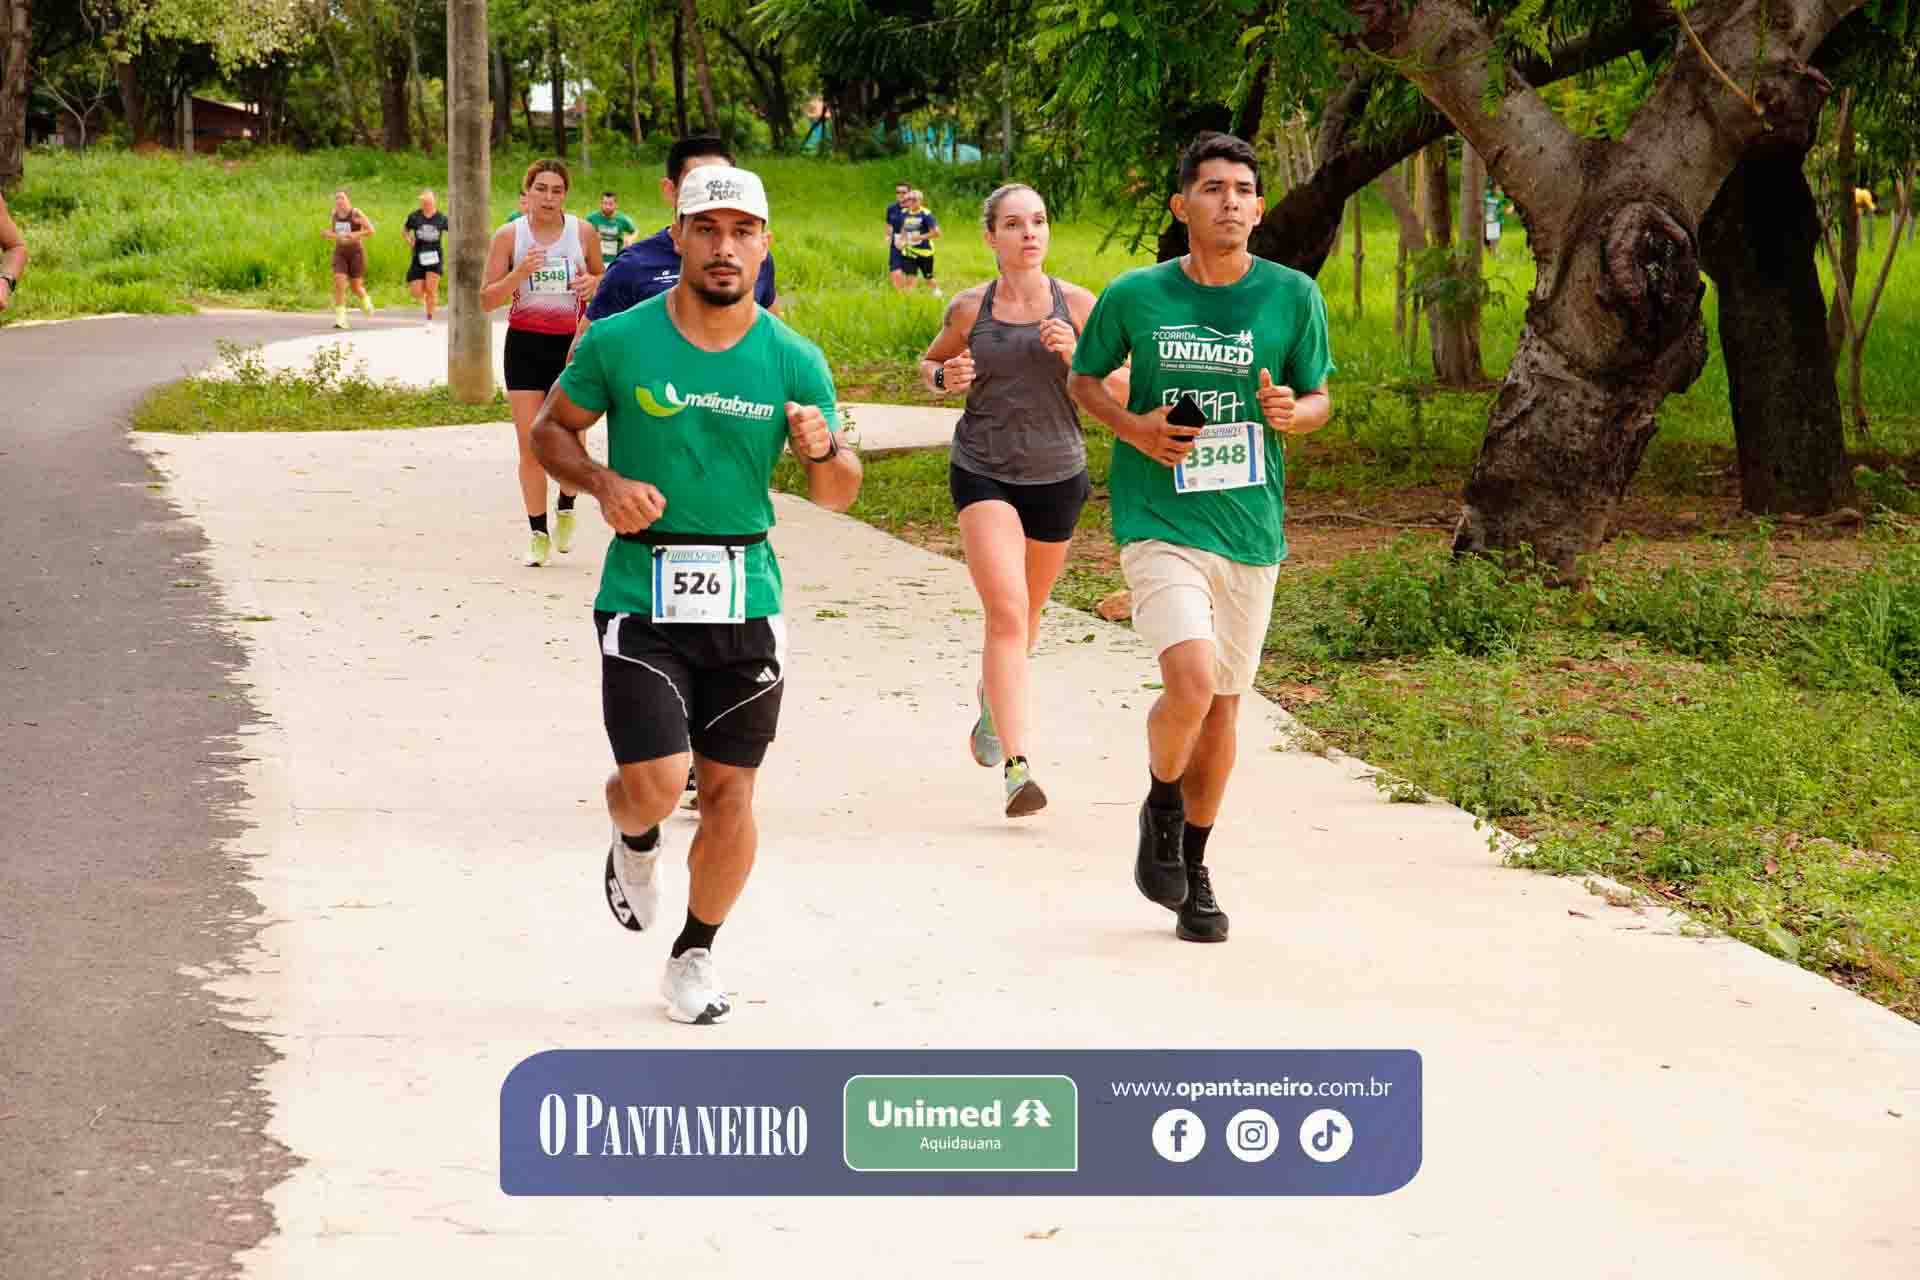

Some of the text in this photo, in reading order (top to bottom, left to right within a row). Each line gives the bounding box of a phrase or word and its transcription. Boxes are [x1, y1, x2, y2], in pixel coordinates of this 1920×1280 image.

[534, 271, 565, 282] 3548
[1159, 331, 1197, 341] CORRIDA
[1159, 341, 1254, 366] UNIMED
[1185, 444, 1246, 468] 3348
[673, 572, 721, 595] 526
